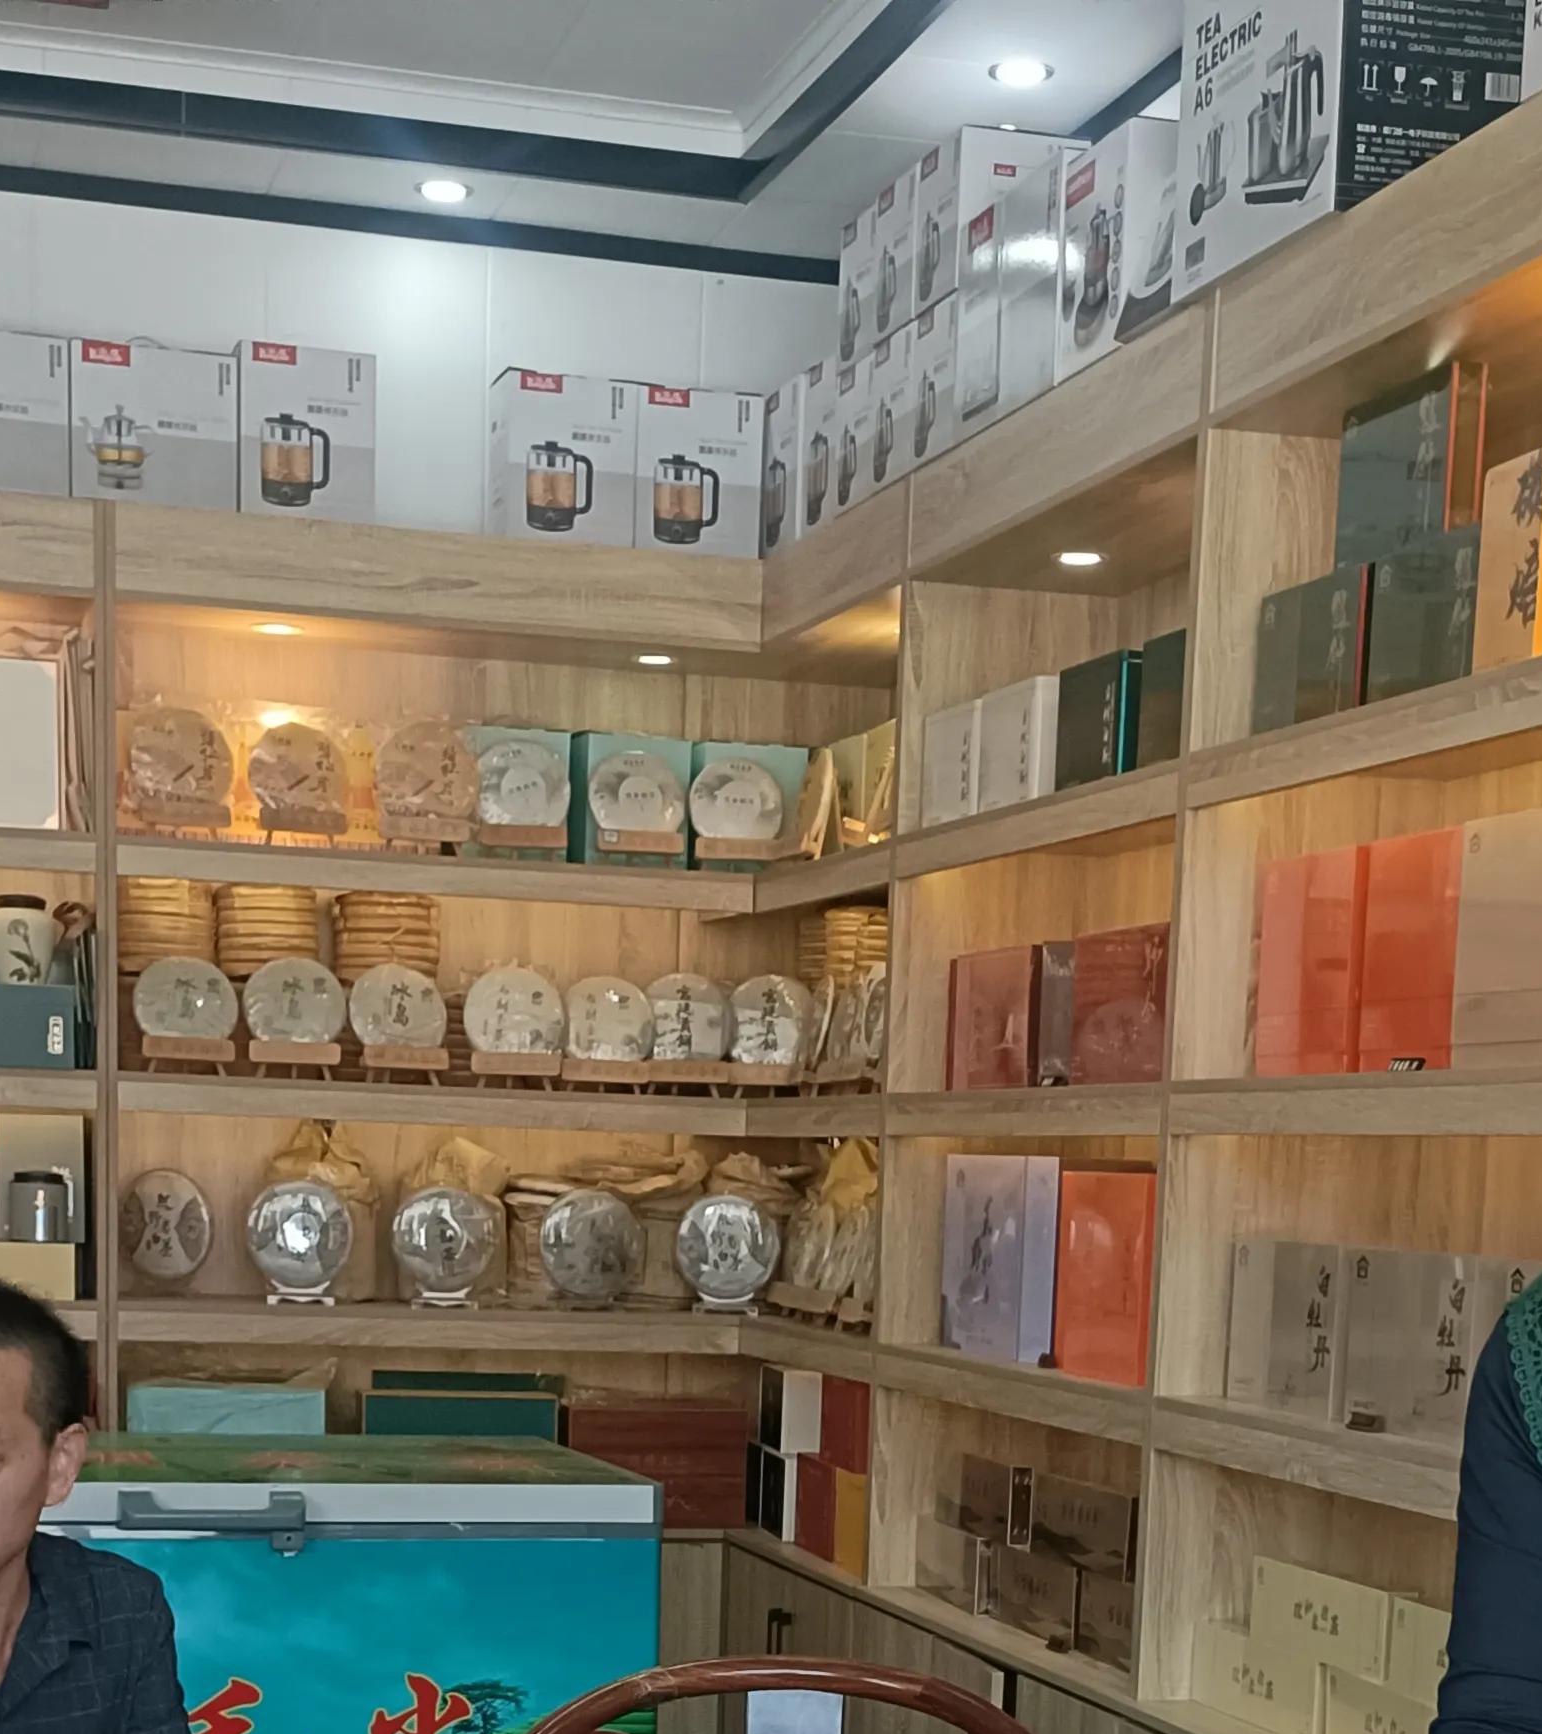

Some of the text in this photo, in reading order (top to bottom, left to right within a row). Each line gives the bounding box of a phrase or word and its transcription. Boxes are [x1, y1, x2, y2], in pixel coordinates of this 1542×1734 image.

[1194, 10, 1263, 82] ELECTRIC
[1195, 12, 1222, 50] TEA
[1193, 77, 1213, 116] A6
